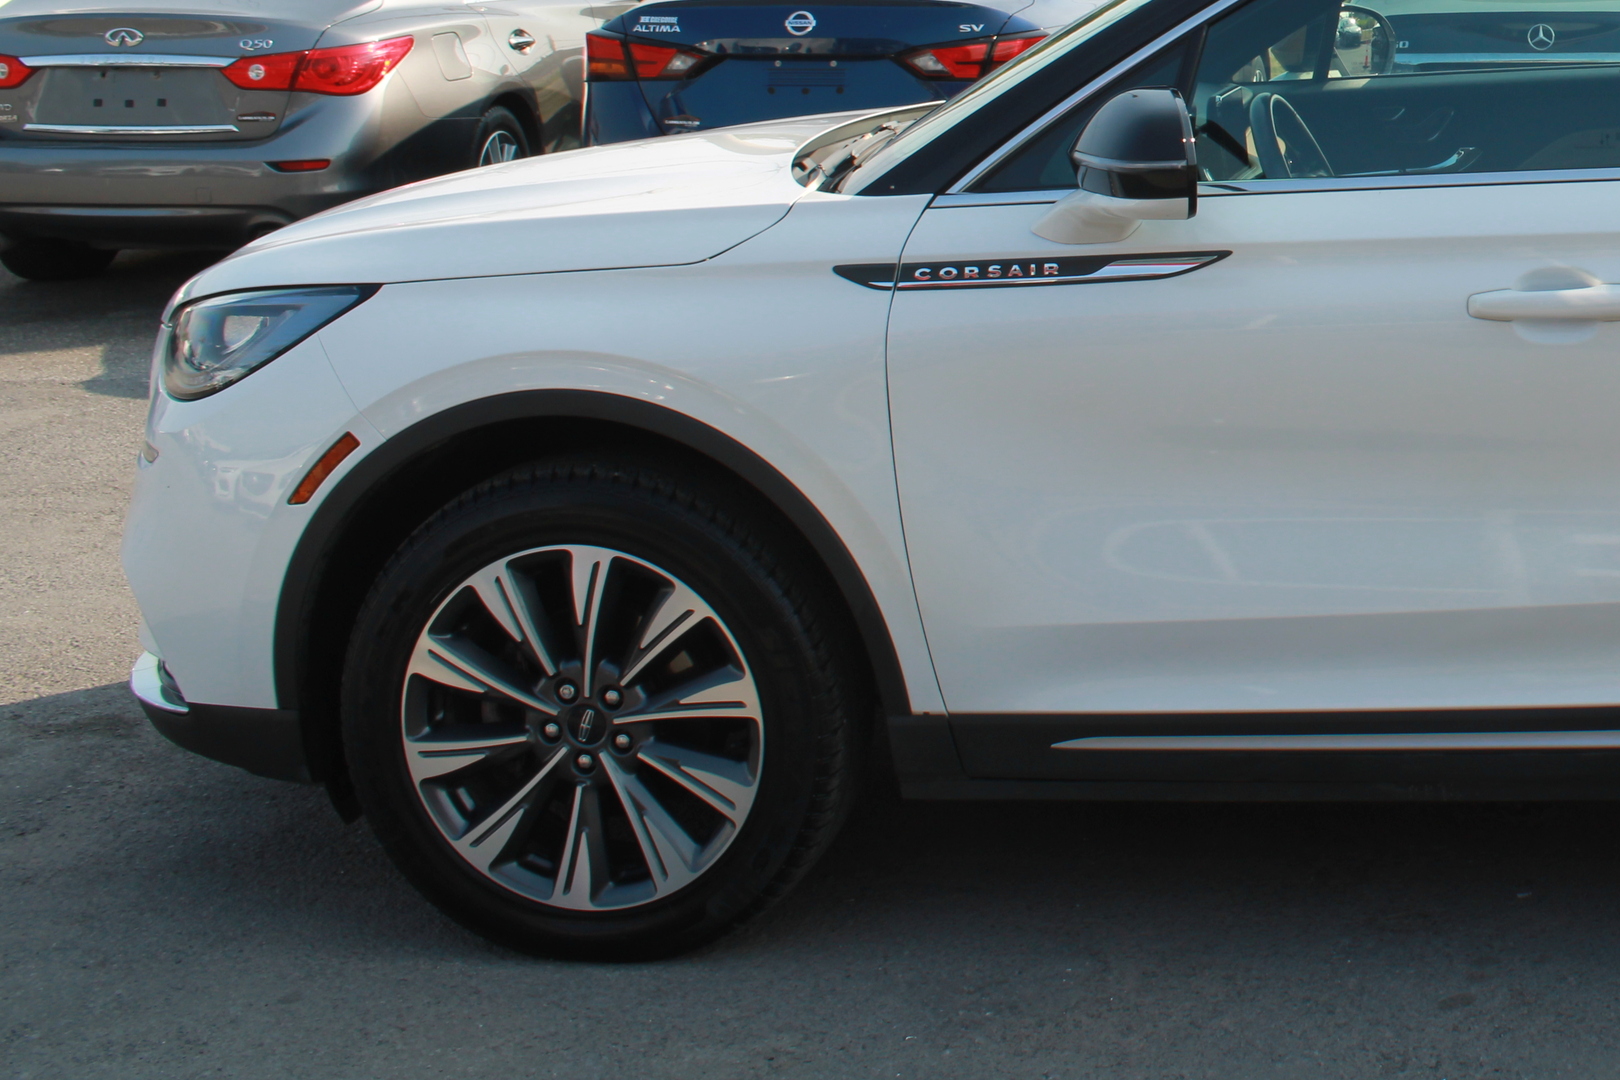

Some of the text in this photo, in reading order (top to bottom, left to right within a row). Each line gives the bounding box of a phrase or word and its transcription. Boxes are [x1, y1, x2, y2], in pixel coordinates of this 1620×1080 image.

[632, 24, 681, 33] ALTIMA
[958, 23, 985, 33] SV
[239, 39, 274, 51] Q50
[914, 263, 1060, 280] CORSAIR
